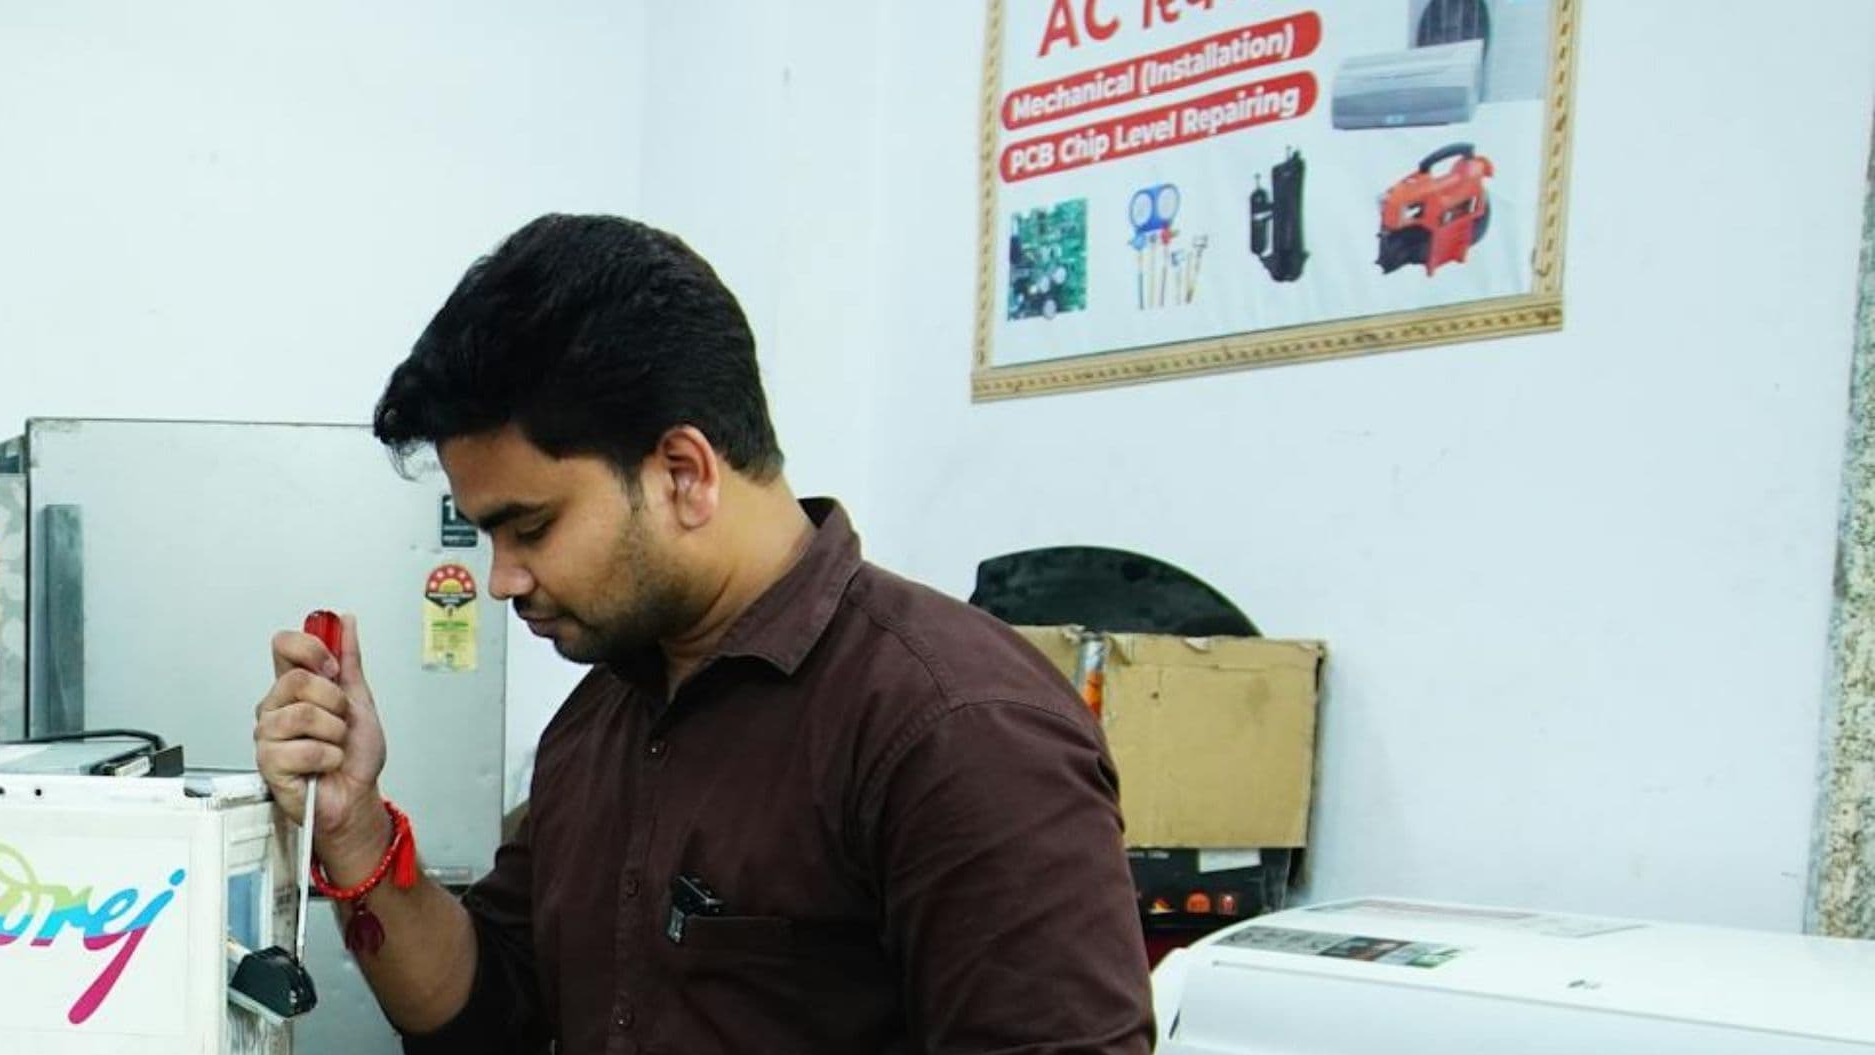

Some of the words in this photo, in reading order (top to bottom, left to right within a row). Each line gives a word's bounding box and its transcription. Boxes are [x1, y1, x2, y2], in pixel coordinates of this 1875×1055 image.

[1010, 66, 1136, 122] Mechanical
[1139, 22, 1295, 94] (Installation)
[1038, 0, 1120, 57] AC
[1009, 141, 1056, 176] PCB
[1058, 128, 1110, 162] Chip
[1114, 110, 1177, 150] Level
[1181, 85, 1301, 134] Repairing
